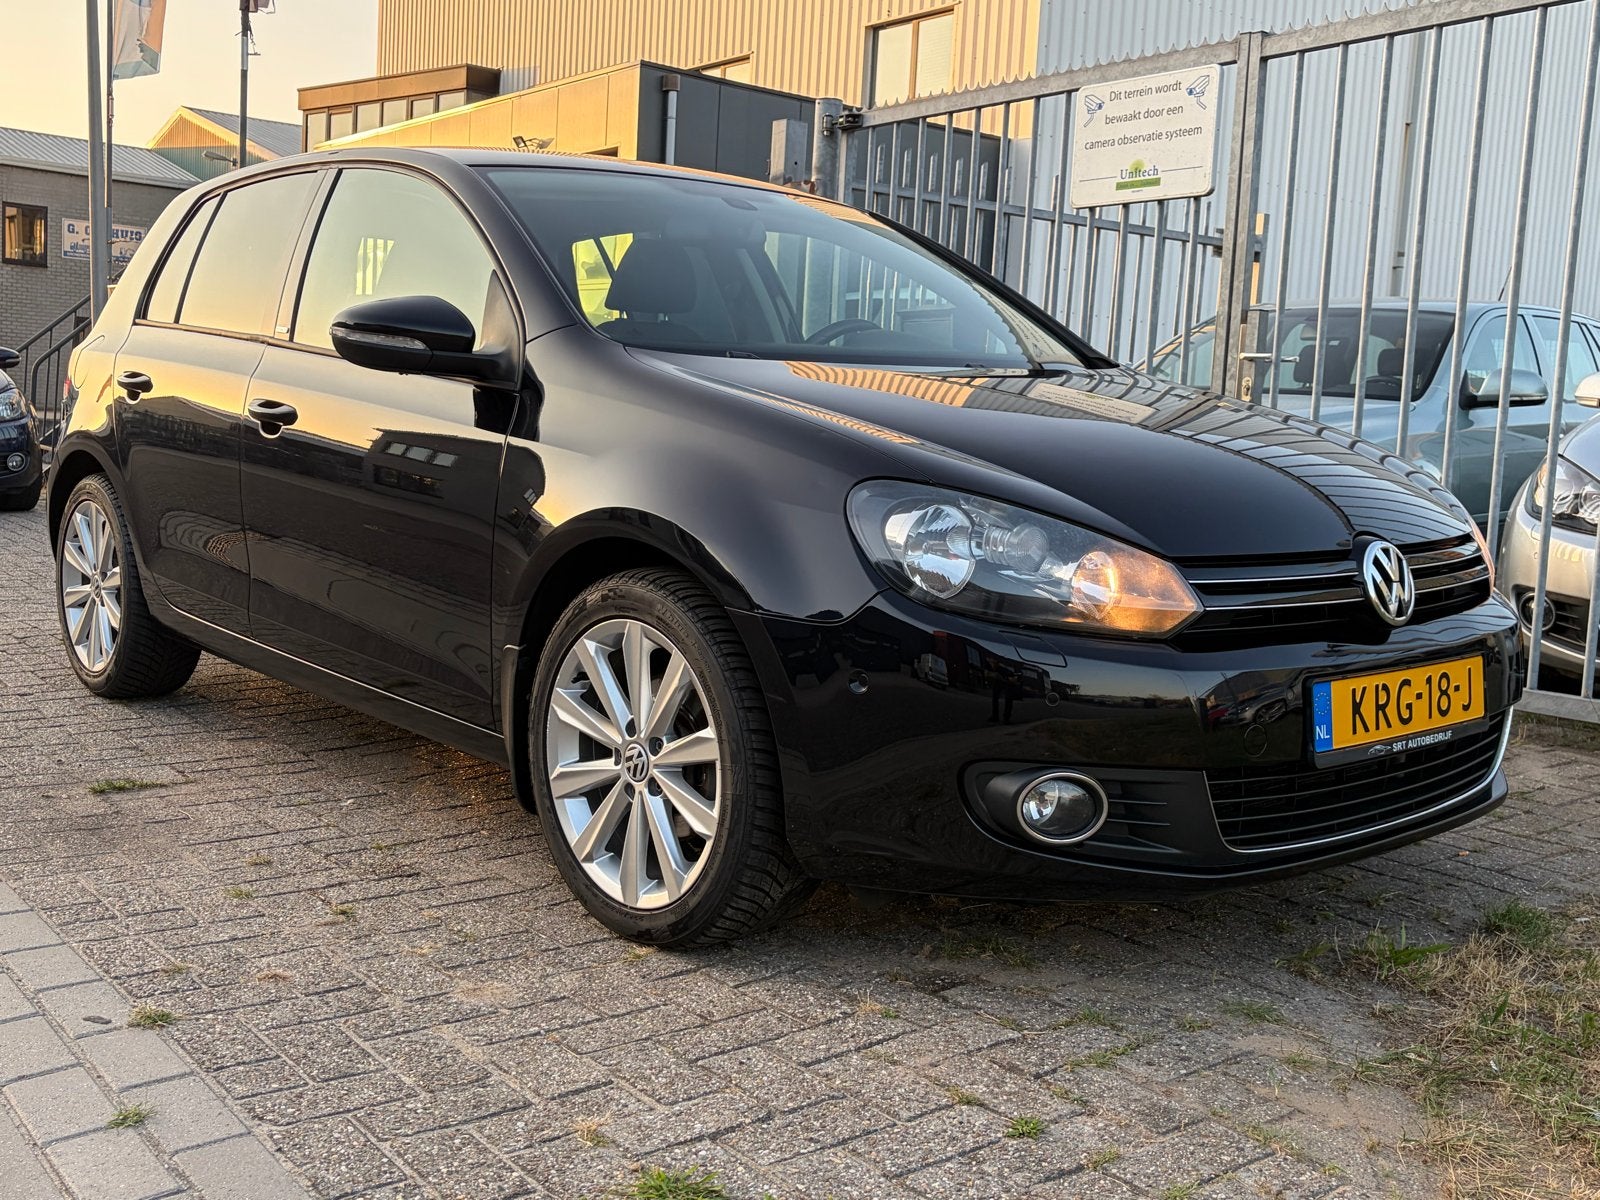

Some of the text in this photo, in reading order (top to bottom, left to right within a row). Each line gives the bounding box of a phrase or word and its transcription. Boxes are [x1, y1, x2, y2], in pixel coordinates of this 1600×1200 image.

[1109, 80, 1182, 102] Dit terrein wordt
[1105, 105, 1184, 125] bewaakt door een
[1084, 125, 1203, 150] camera observatie systeem
[1120, 164, 1159, 180] Unitech
[67, 223, 79, 234] G.
[1351, 666, 1472, 736] KRG-18-J
[1316, 724, 1330, 740] NL
[1392, 730, 1453, 752] SRT AUTOBEDRIJF
